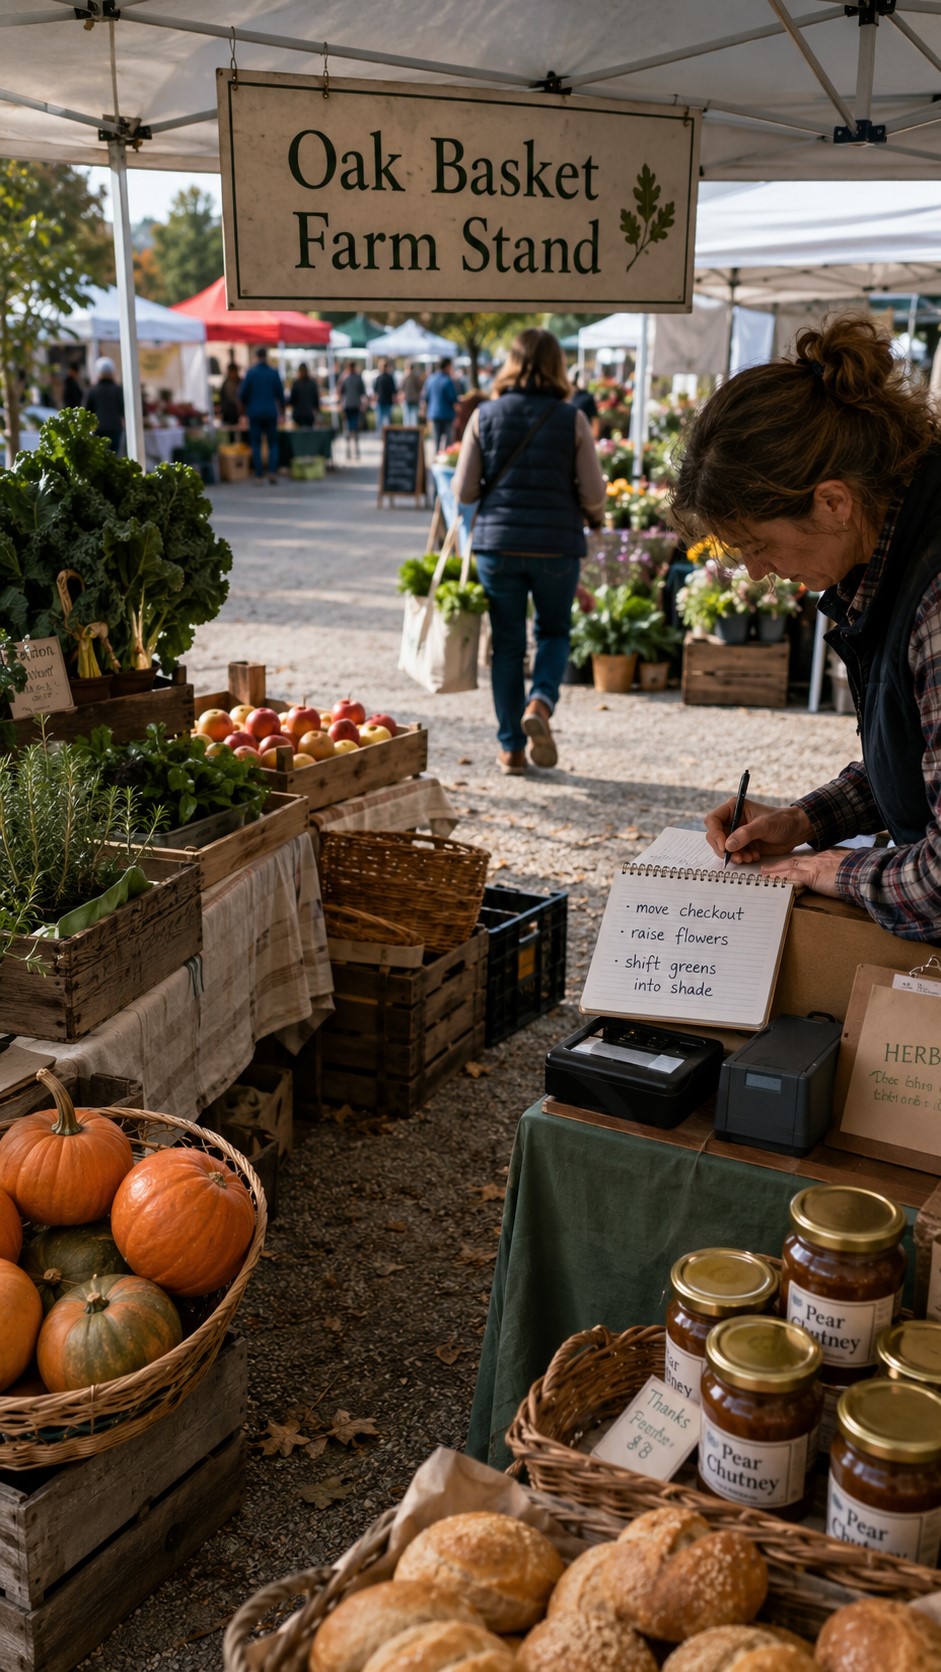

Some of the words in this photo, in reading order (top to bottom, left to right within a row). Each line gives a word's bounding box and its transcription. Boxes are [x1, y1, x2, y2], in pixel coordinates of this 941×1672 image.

[288, 129, 406, 192] Oak
[430, 136, 600, 201] Basket
[292, 211, 440, 272] Farm
[461, 216, 602, 275] Stand
[635, 903, 670, 916] move
[679, 903, 745, 921] checkout
[631, 927, 665, 941] raise
[675, 927, 729, 946] flowers
[624, 954, 662, 973] shift
[668, 960, 717, 979] greens
[634, 978, 662, 992] into
[670, 981, 714, 997] shade
[884, 1042, 941, 1066] HERB
[806, 1303, 846, 1330] Pear
[647, 1388, 691, 1429] Thanks
[722, 1443, 763, 1471] Pear
[707, 1453, 780, 1497] Chutney
[846, 1508, 889, 1542] Pear
